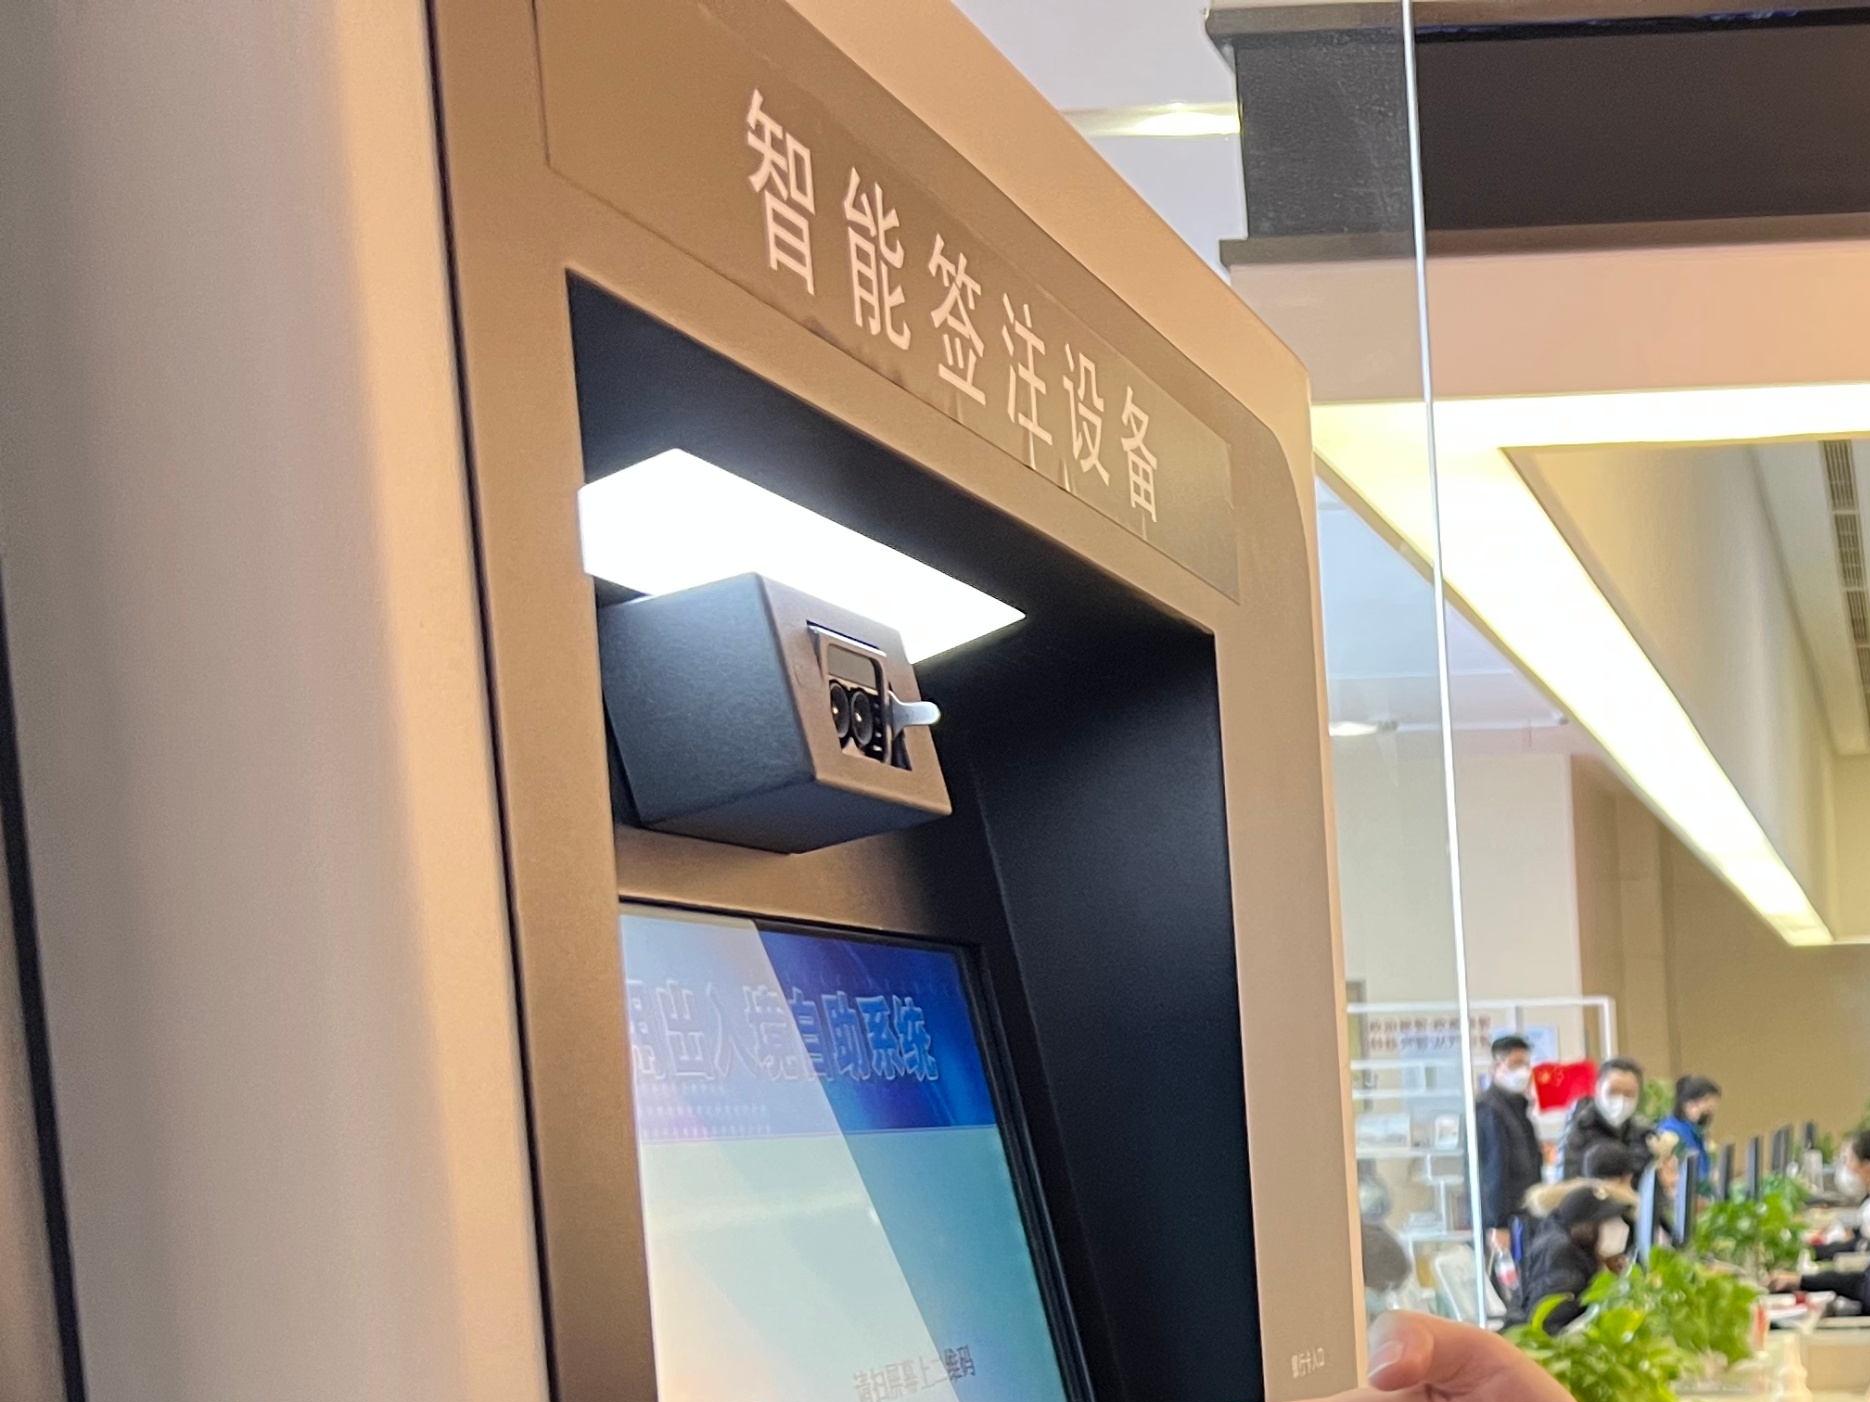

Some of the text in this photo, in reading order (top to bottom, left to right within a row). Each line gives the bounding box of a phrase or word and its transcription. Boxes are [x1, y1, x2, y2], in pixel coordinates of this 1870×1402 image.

[744, 88, 1160, 523] 智能签注设备
